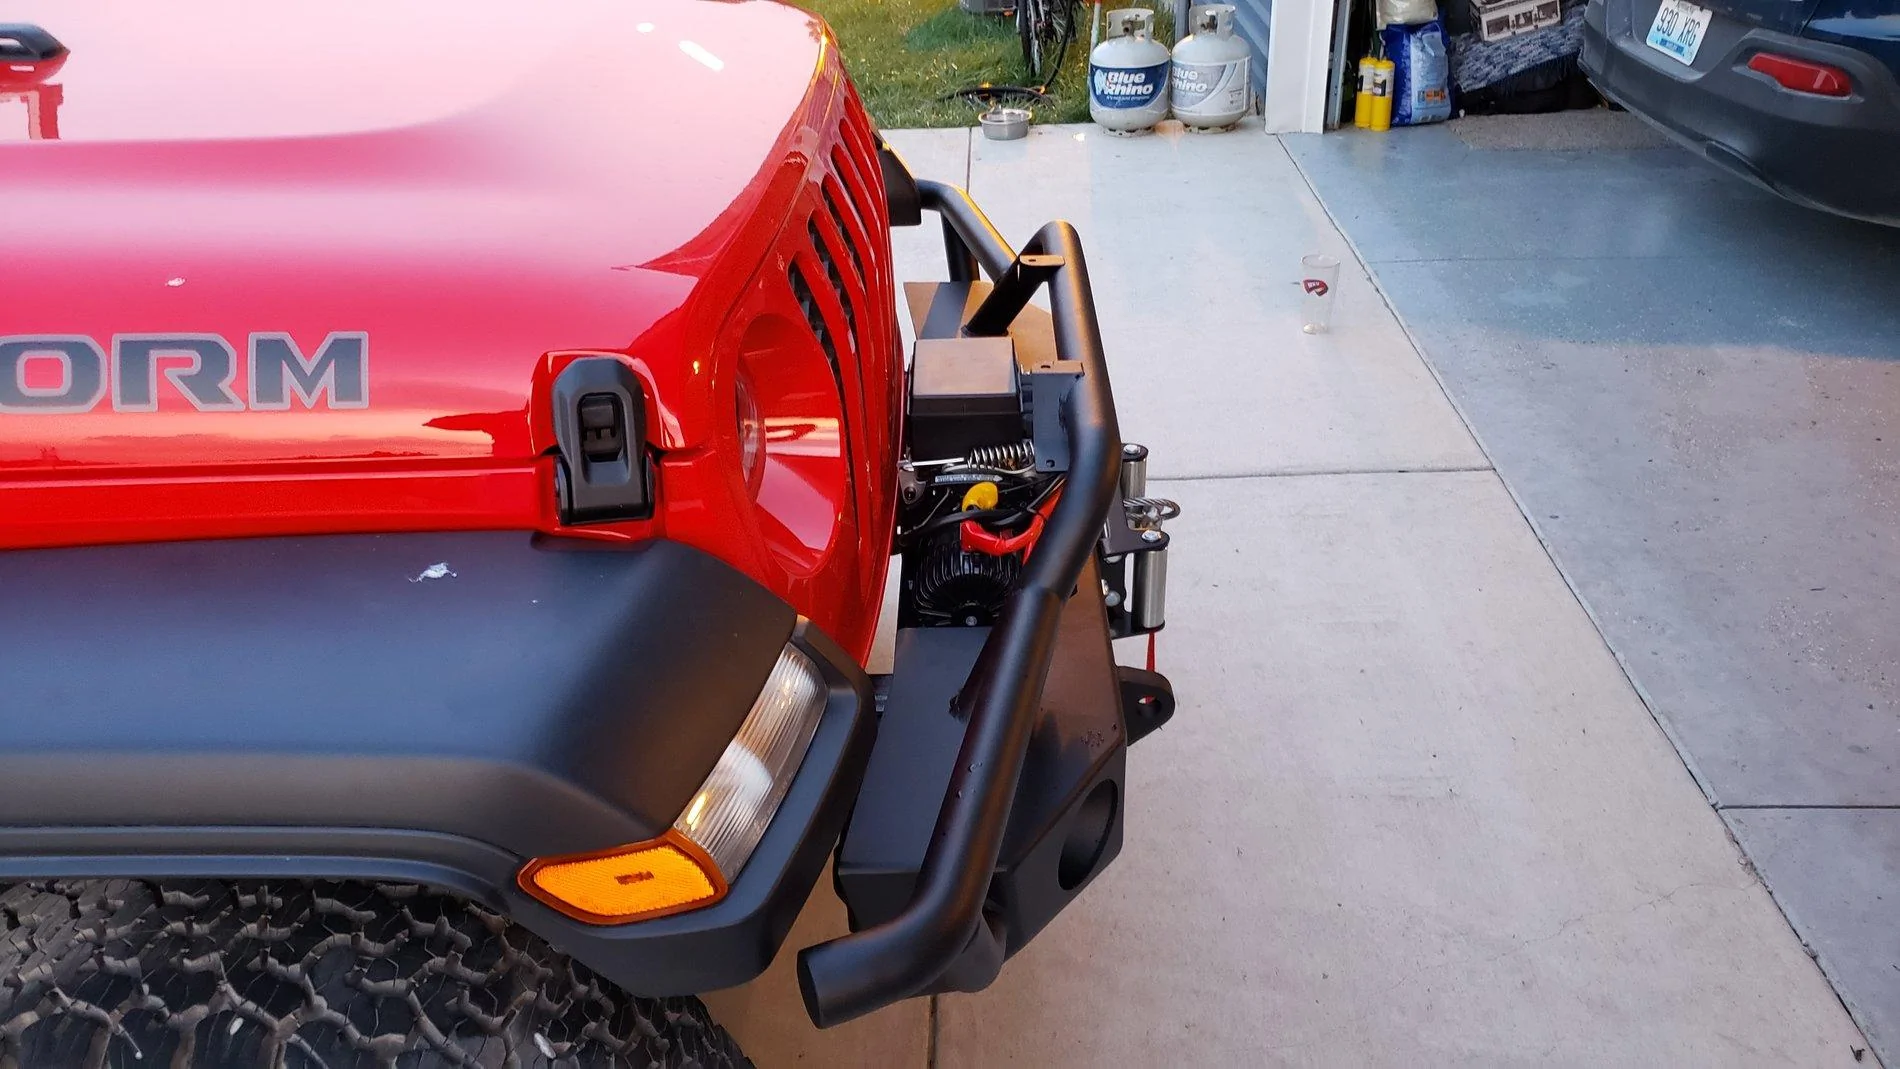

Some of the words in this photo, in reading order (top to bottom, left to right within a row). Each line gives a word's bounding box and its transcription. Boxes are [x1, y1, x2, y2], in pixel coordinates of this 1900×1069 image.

[1656, 7, 1679, 37] 930
[1108, 71, 1146, 84] Blue
[1105, 83, 1153, 95] Rhino
[0, 331, 369, 413] ORM
